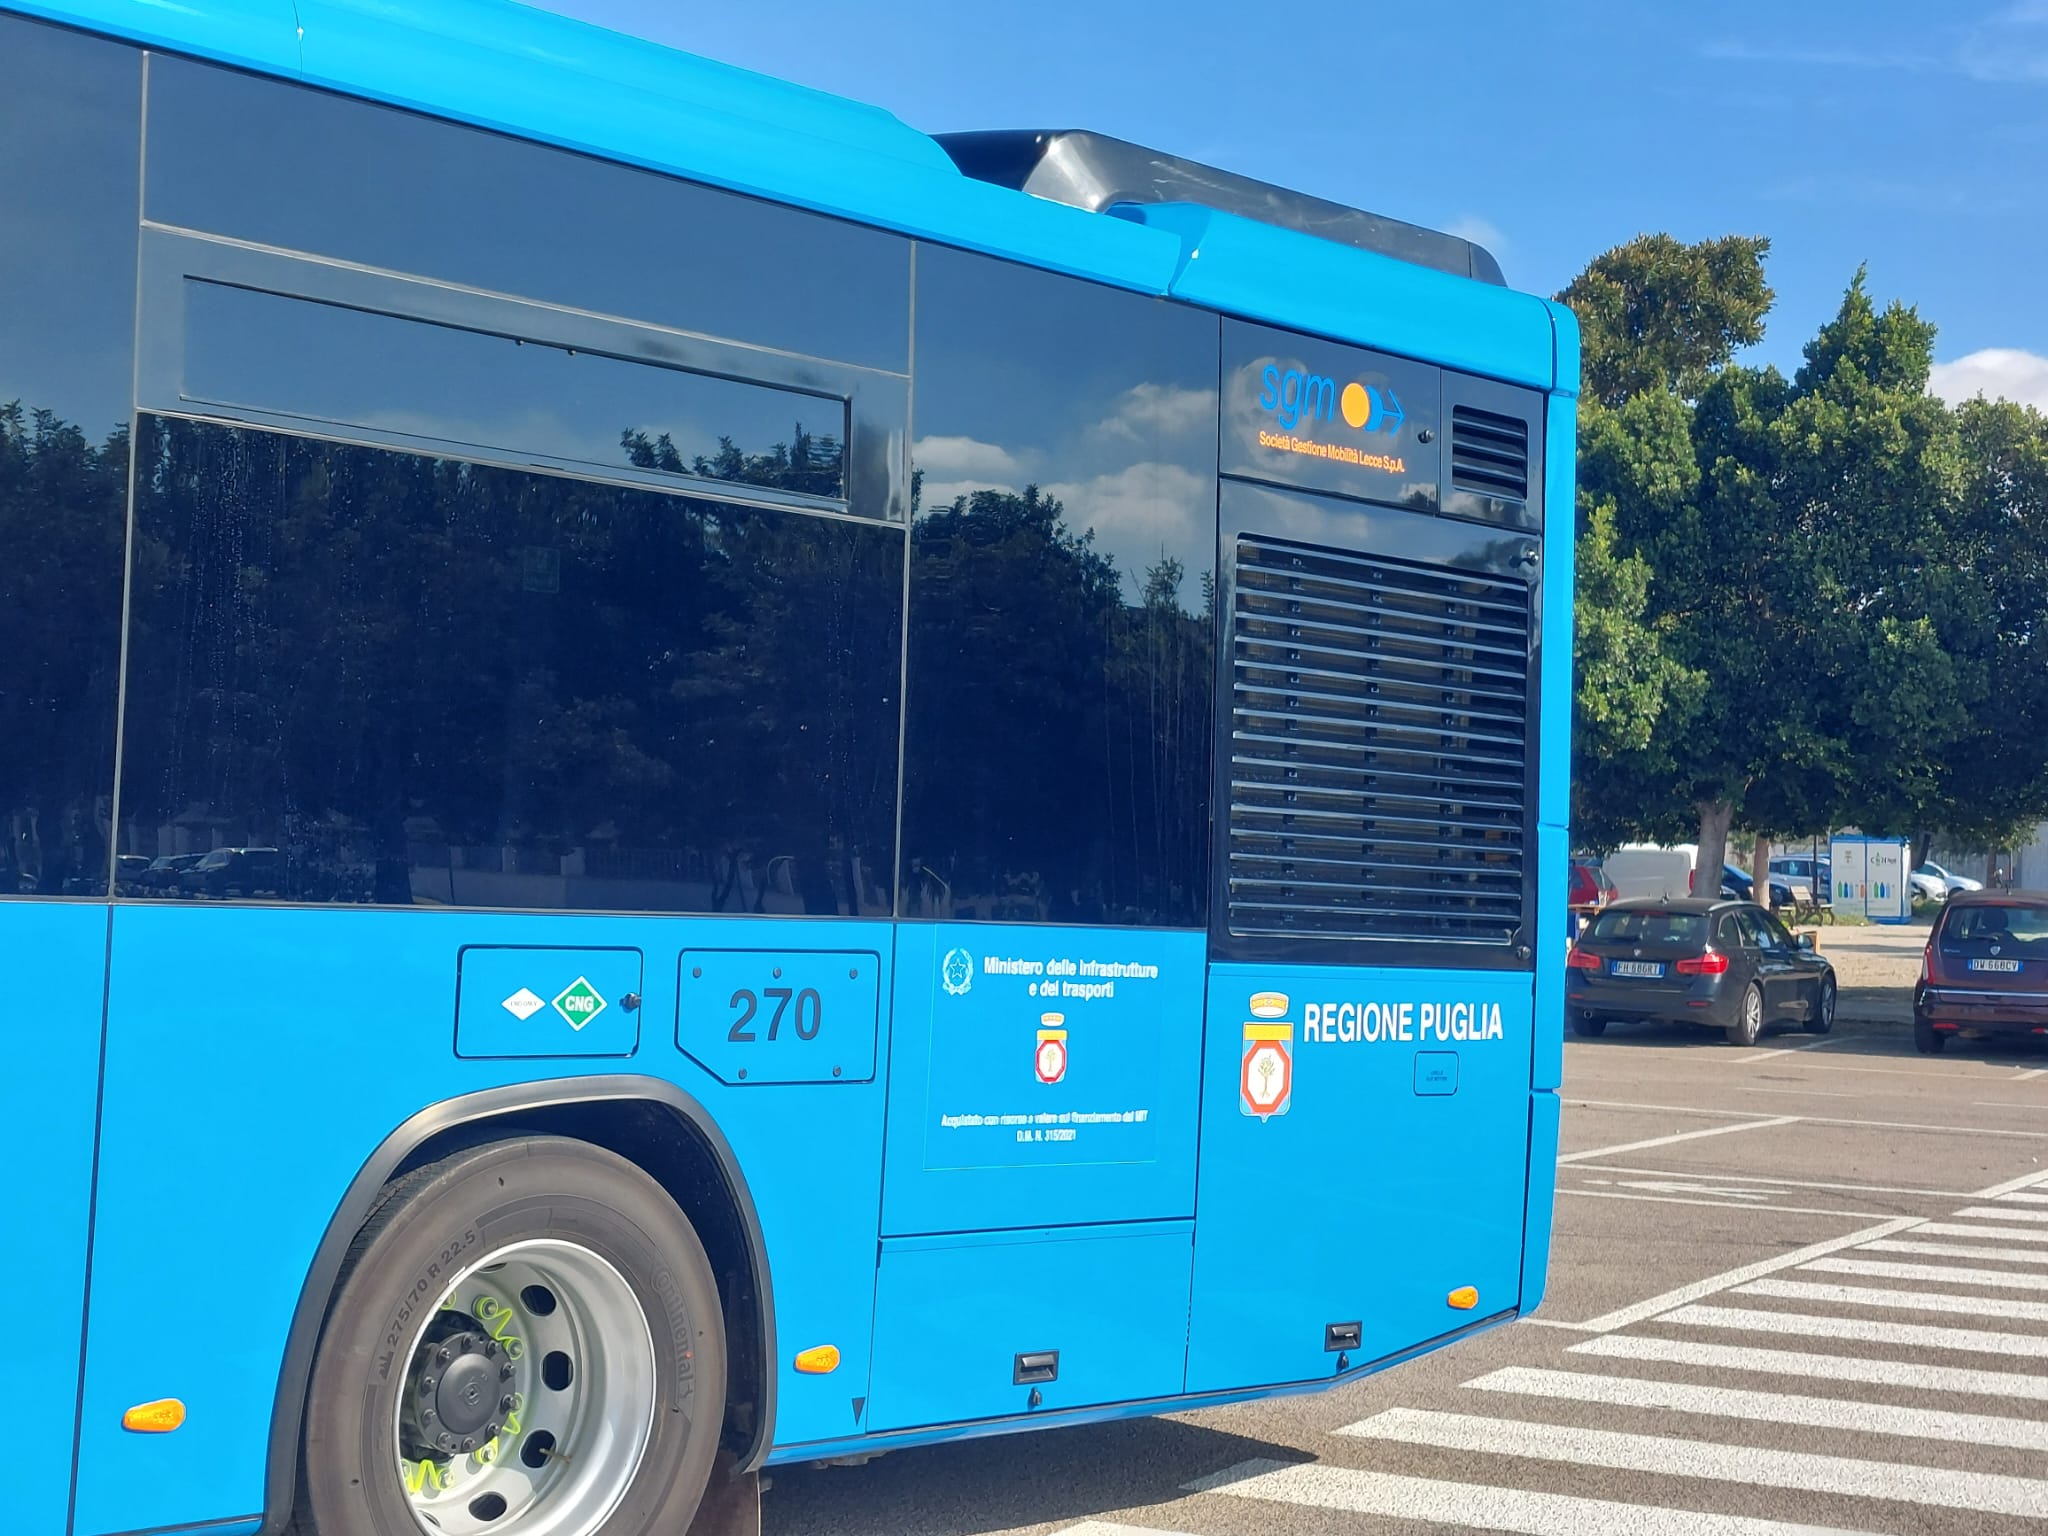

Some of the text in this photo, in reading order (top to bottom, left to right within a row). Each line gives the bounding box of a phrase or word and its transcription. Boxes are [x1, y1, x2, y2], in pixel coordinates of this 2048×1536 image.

[1259, 363, 1337, 430] sgm
[1259, 430, 1406, 474] Società Gestione Mobilità Lecce S.p.A.
[984, 956, 1044, 976] Ministero
[1046, 958, 1077, 977] delle
[565, 995, 595, 1012] CNG
[1028, 980, 1115, 1002] e dei trasporti
[728, 986, 822, 1043] 270
[1303, 1002, 1504, 1043] REGIONE PUGLIA
[984, 1115, 999, 1126] con
[386, 1229, 477, 1348] 275/70 R 22.5
